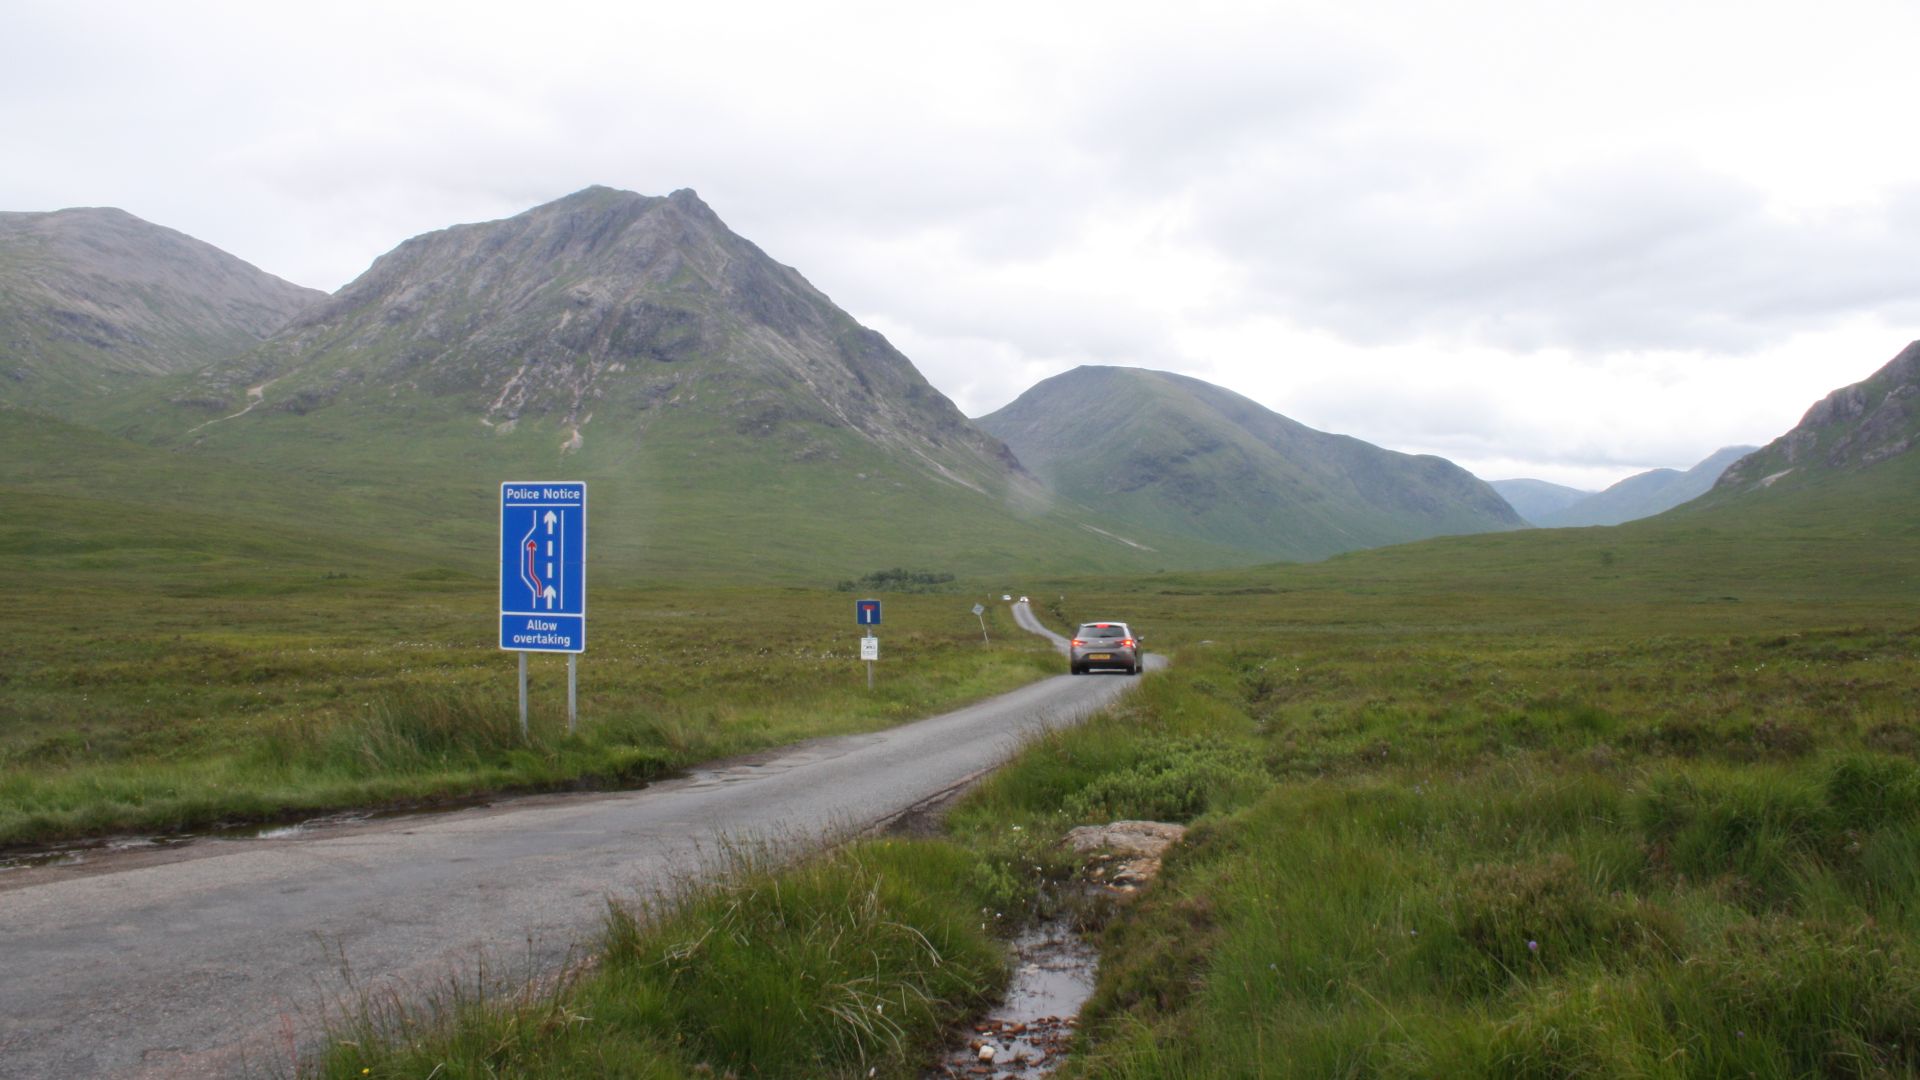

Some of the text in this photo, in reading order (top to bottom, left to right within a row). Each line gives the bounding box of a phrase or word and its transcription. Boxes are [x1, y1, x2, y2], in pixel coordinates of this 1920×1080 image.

[507, 488, 581, 500] Police Notice
[526, 619, 558, 631] Allow
[513, 633, 571, 647] overtaking
